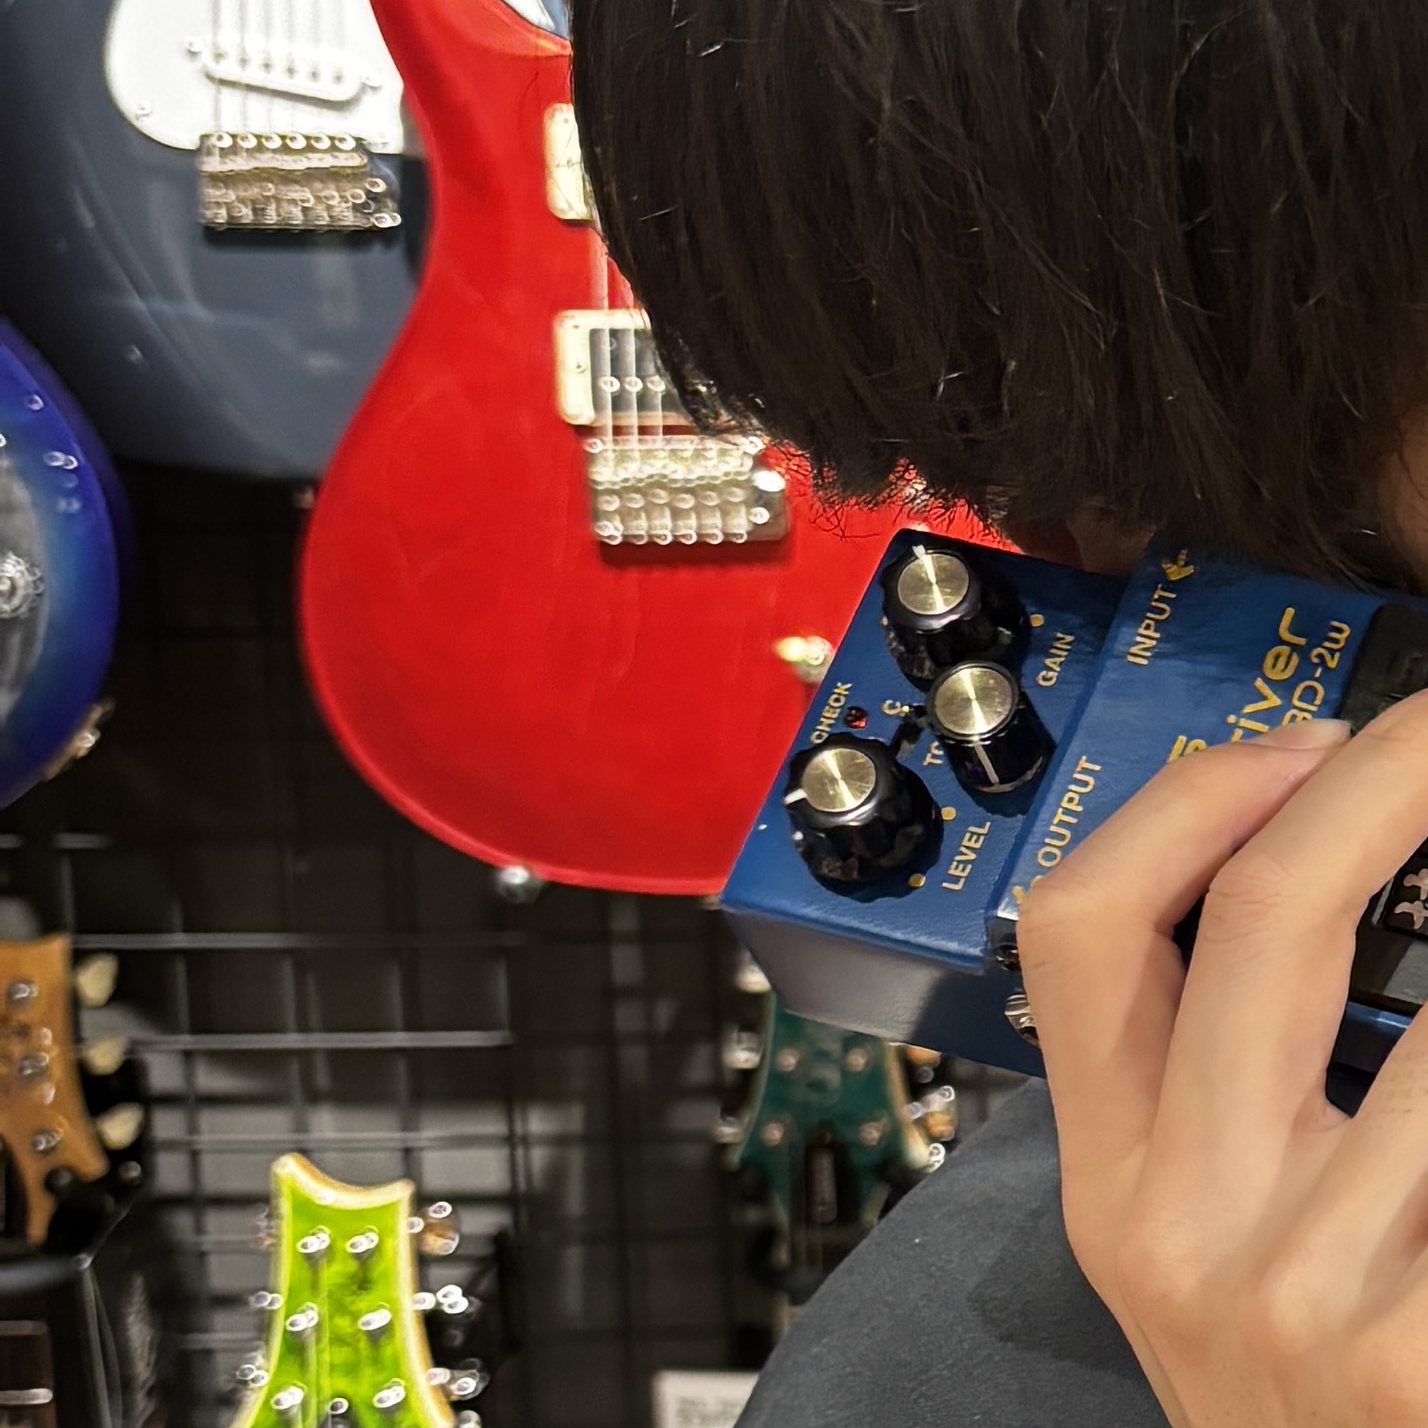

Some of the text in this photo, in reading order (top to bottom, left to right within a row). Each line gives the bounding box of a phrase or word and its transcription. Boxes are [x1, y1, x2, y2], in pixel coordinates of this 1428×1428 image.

[1036, 632, 1076, 688] GAIN
[1126, 582, 1178, 667] INPUT
[810, 681, 853, 745] CHECK
[1035, 754, 1103, 868] OUTPUT
[940, 820, 993, 892] LEVEL
